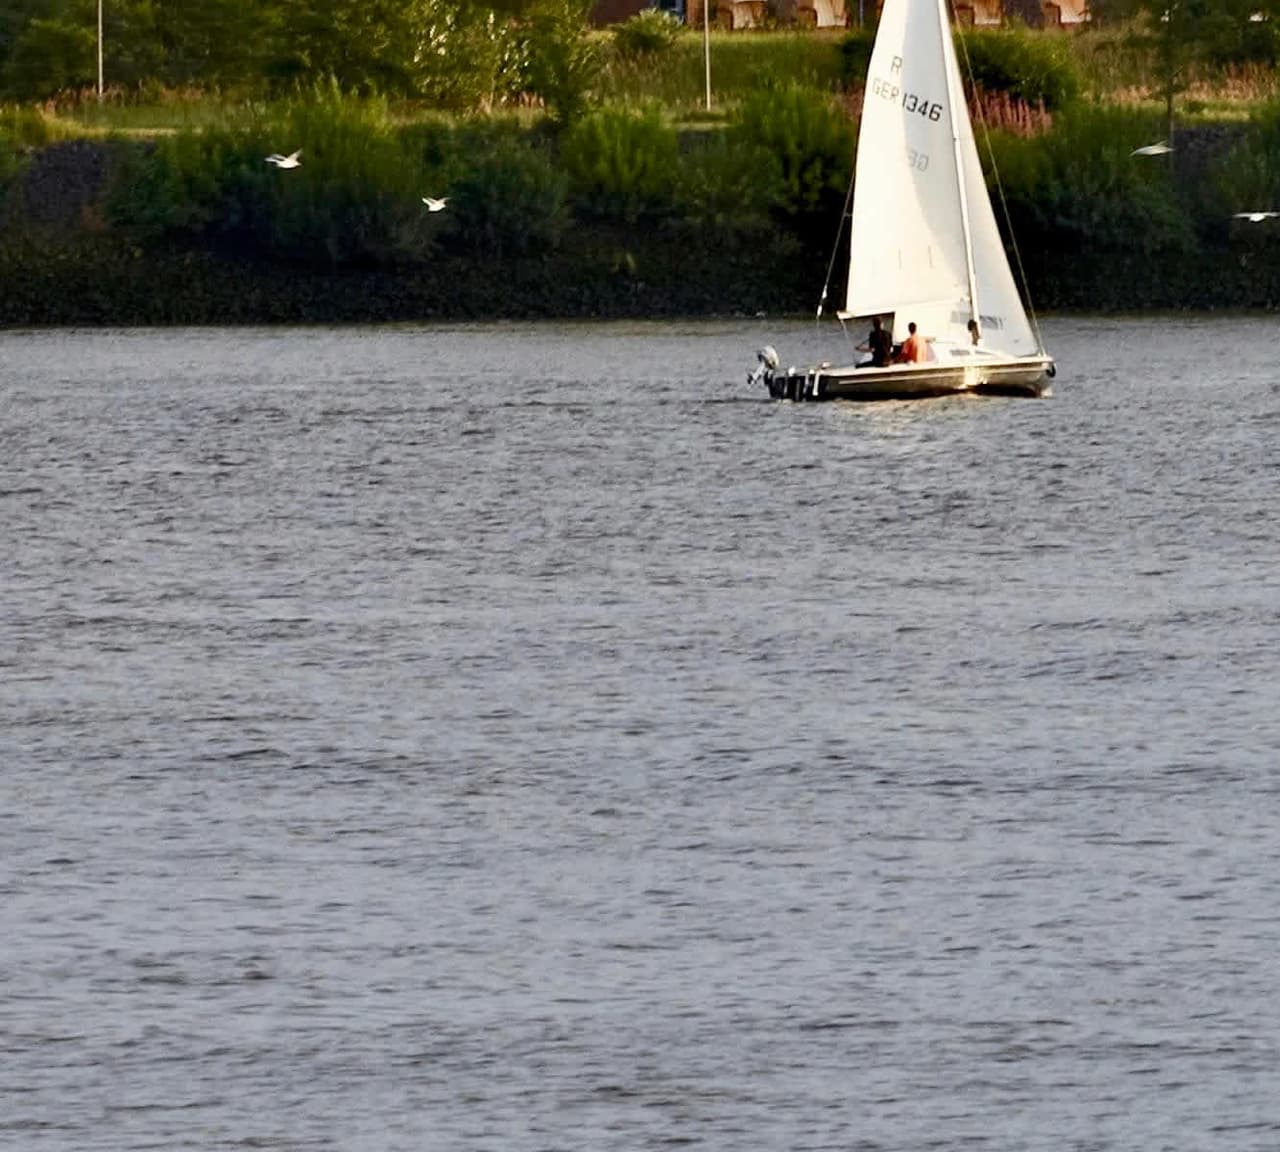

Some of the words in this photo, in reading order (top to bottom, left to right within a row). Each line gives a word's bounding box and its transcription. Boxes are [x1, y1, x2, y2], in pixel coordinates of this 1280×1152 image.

[891, 55, 903, 75] R
[872, 77, 900, 104] GER
[902, 93, 943, 122] 1346
